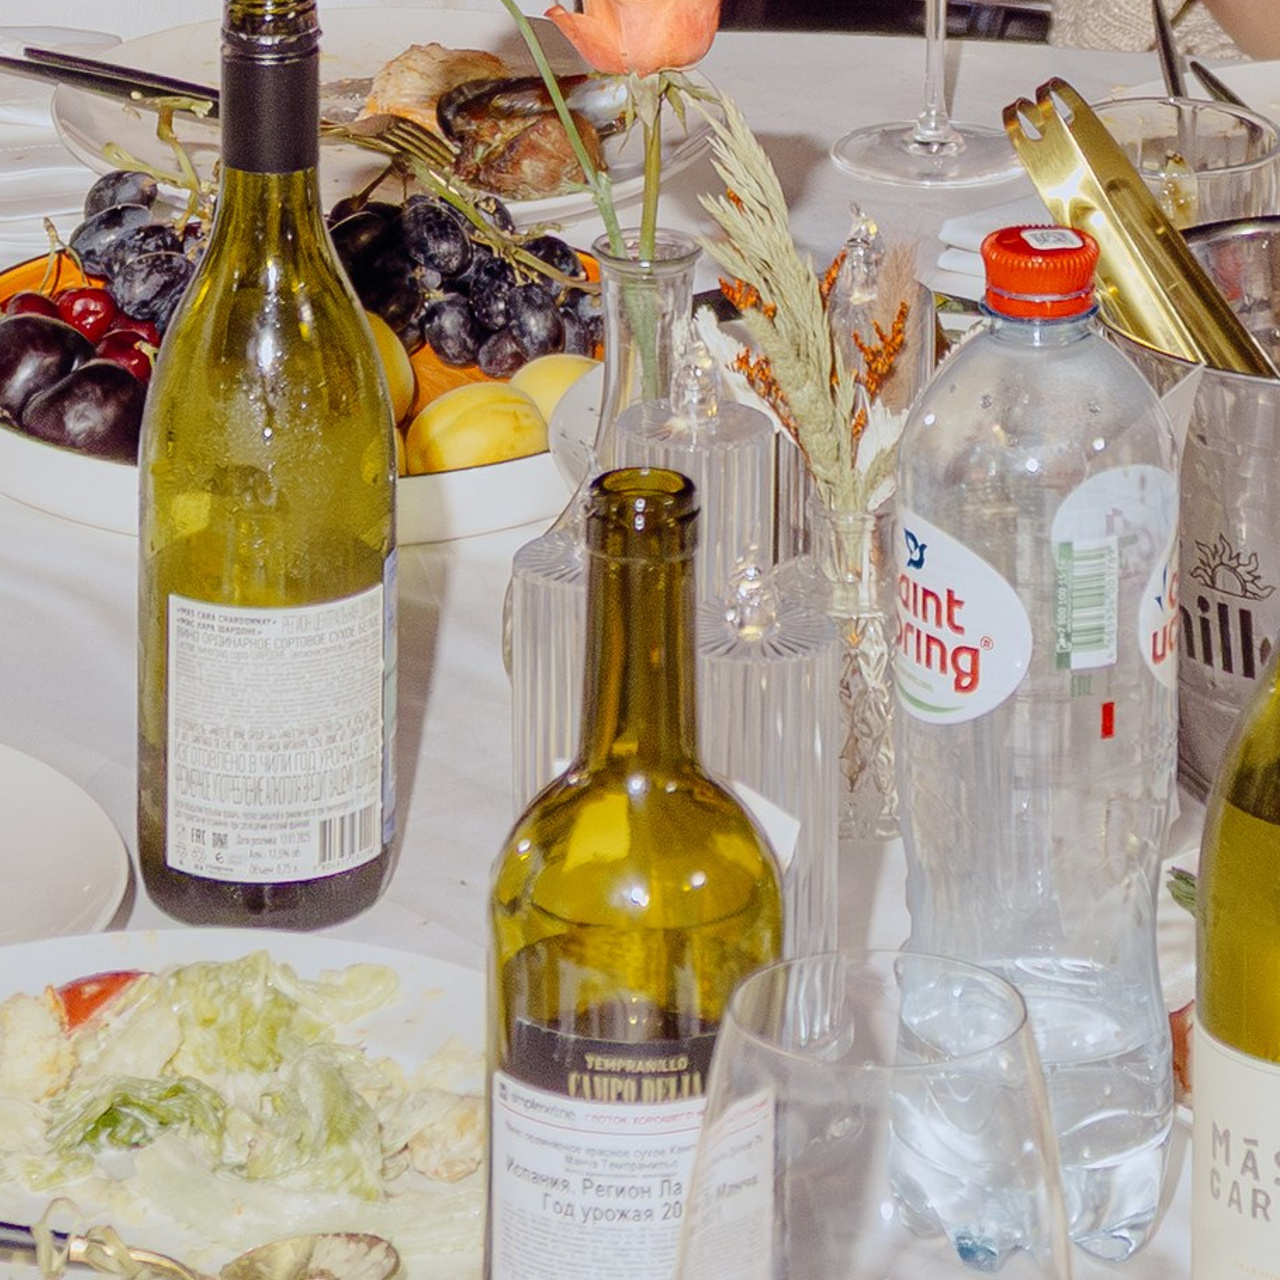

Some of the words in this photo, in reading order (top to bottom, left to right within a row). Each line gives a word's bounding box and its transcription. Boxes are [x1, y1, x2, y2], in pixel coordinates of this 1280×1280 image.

[202, 632, 272, 650] ОРДИНАРНОЕ
[273, 632, 326, 650] СОРТОВОЕ
[585, 1053, 688, 1073] TEMPRANILLO
[582, 1178, 652, 1200] Регион
[659, 1178, 683, 1198] Ла
[542, 1193, 574, 1217] Год
[580, 1202, 655, 1225] урожая
